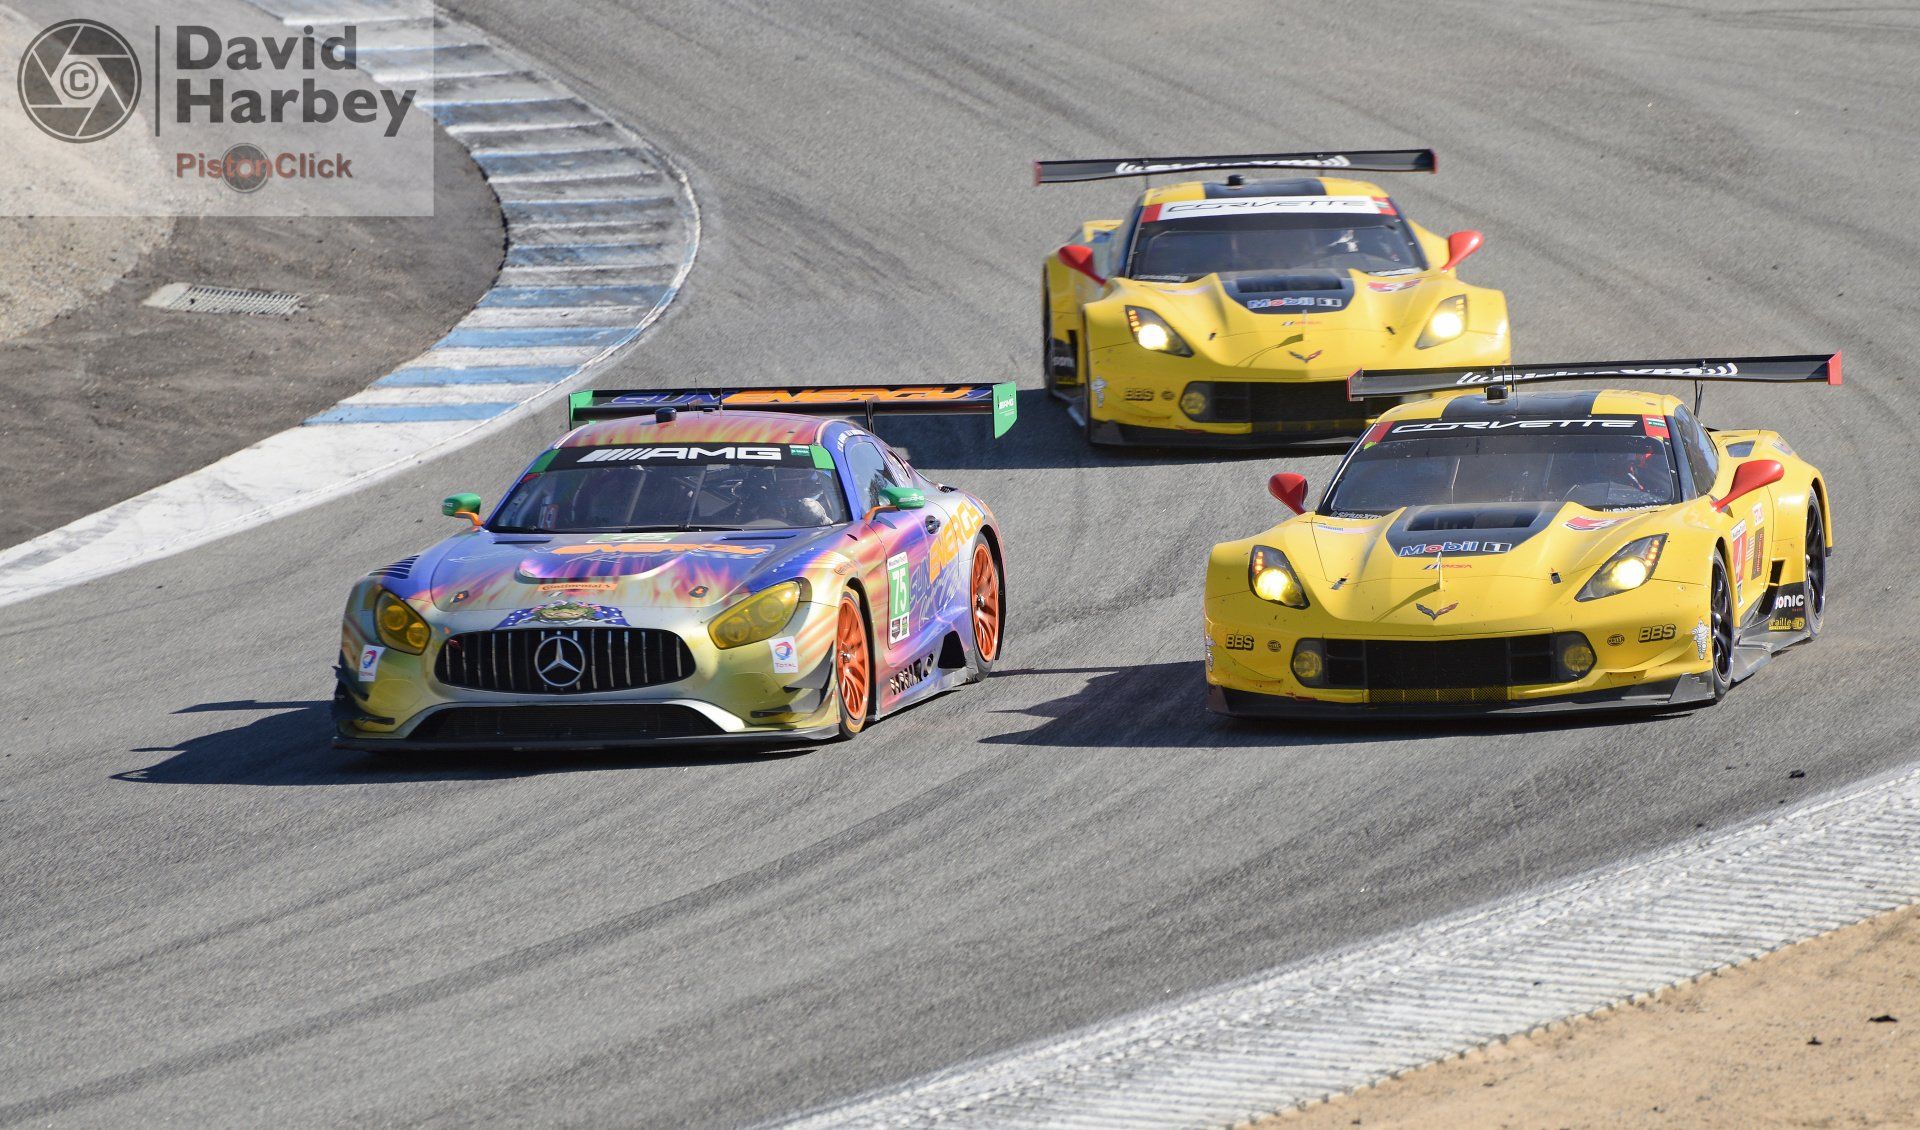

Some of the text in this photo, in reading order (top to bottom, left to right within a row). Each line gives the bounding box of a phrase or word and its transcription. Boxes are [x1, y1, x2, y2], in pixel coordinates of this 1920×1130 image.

[1168, 199, 1366, 213] CORVETTE
[1247, 297, 1314, 309] Mobil
[1125, 387, 1154, 401] BBS
[1391, 419, 1638, 434] CORVETTE
[642, 447, 782, 460] AMG
[1399, 541, 1478, 557] Mobil
[542, 583, 602, 591] Continental
[892, 567, 907, 615] 75
[1639, 624, 1676, 642] BBS
[1226, 633, 1254, 651] BBS
